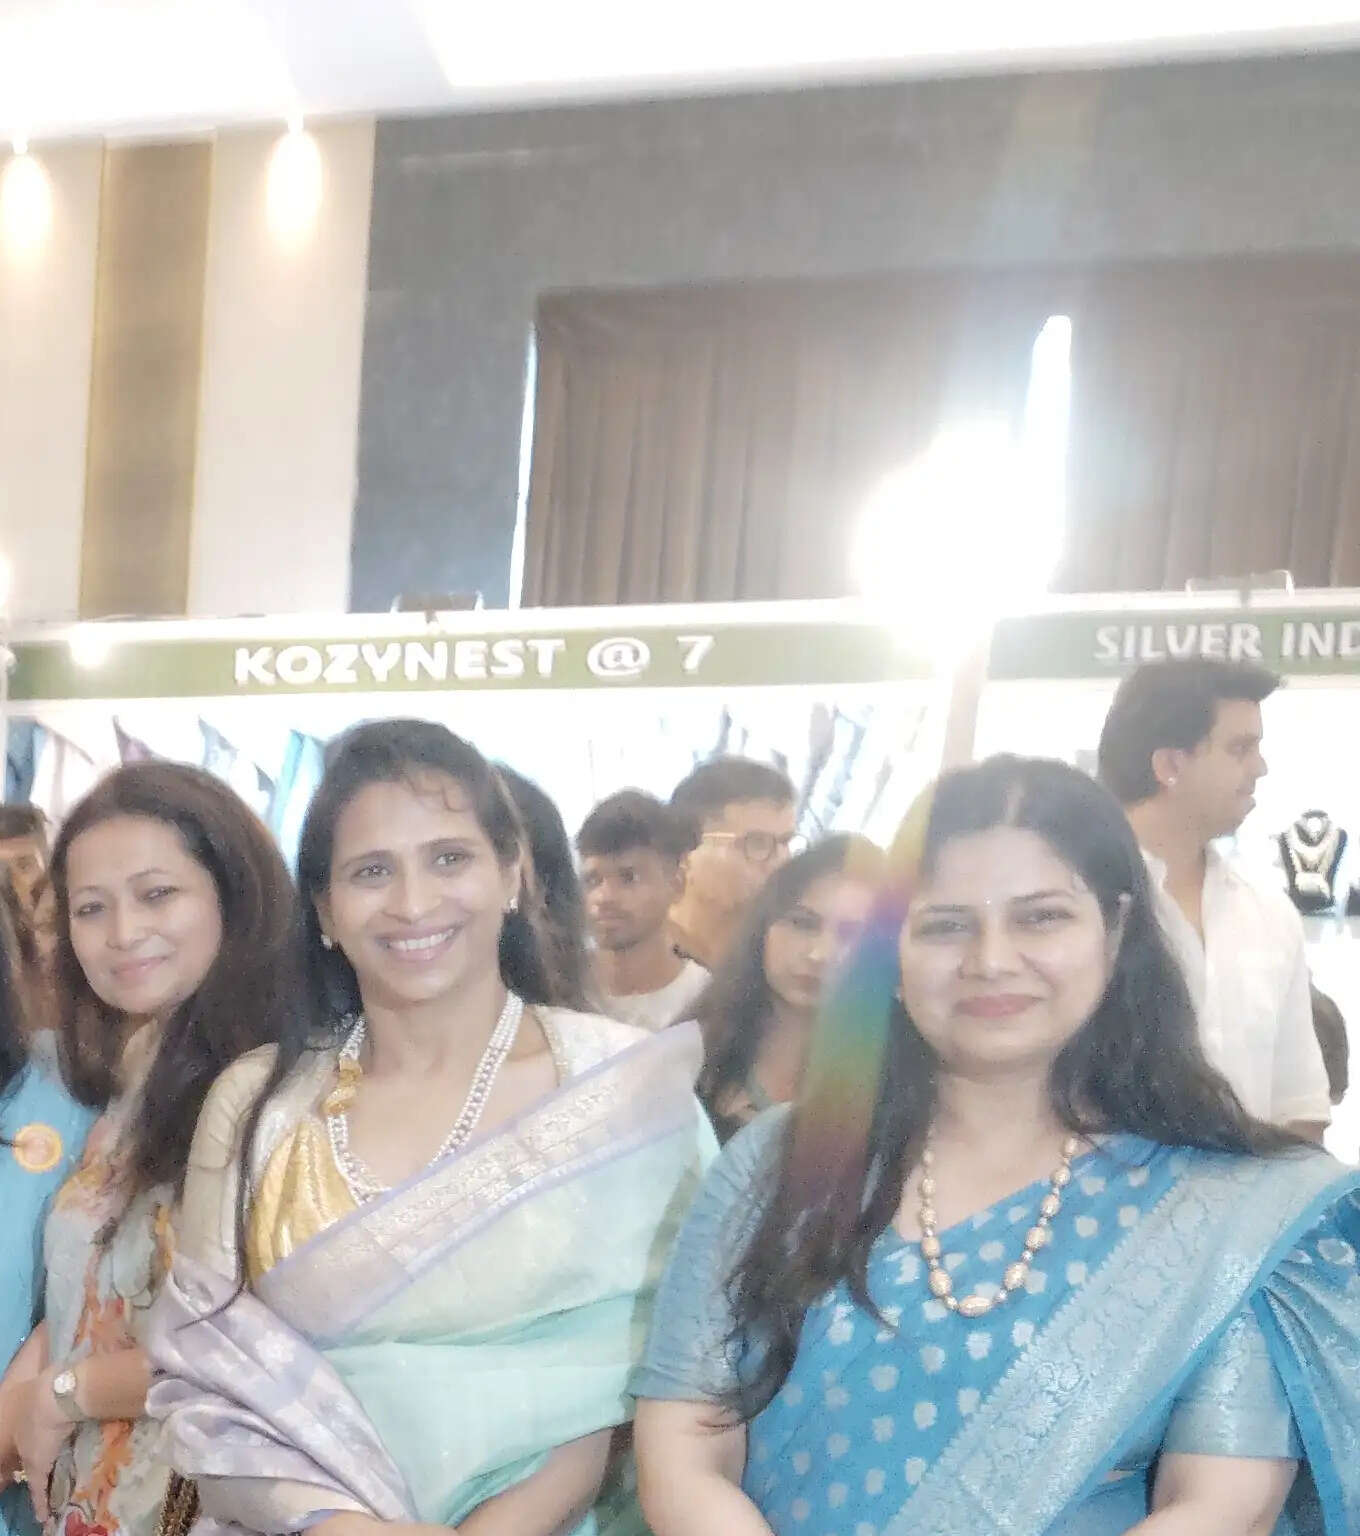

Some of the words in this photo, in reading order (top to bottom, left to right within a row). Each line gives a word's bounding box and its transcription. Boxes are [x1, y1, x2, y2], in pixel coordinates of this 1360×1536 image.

[233, 638, 566, 687] KOZYNEST
[586, 637, 651, 678] @
[676, 635, 716, 674] 7
[1093, 621, 1264, 660] SILVER
